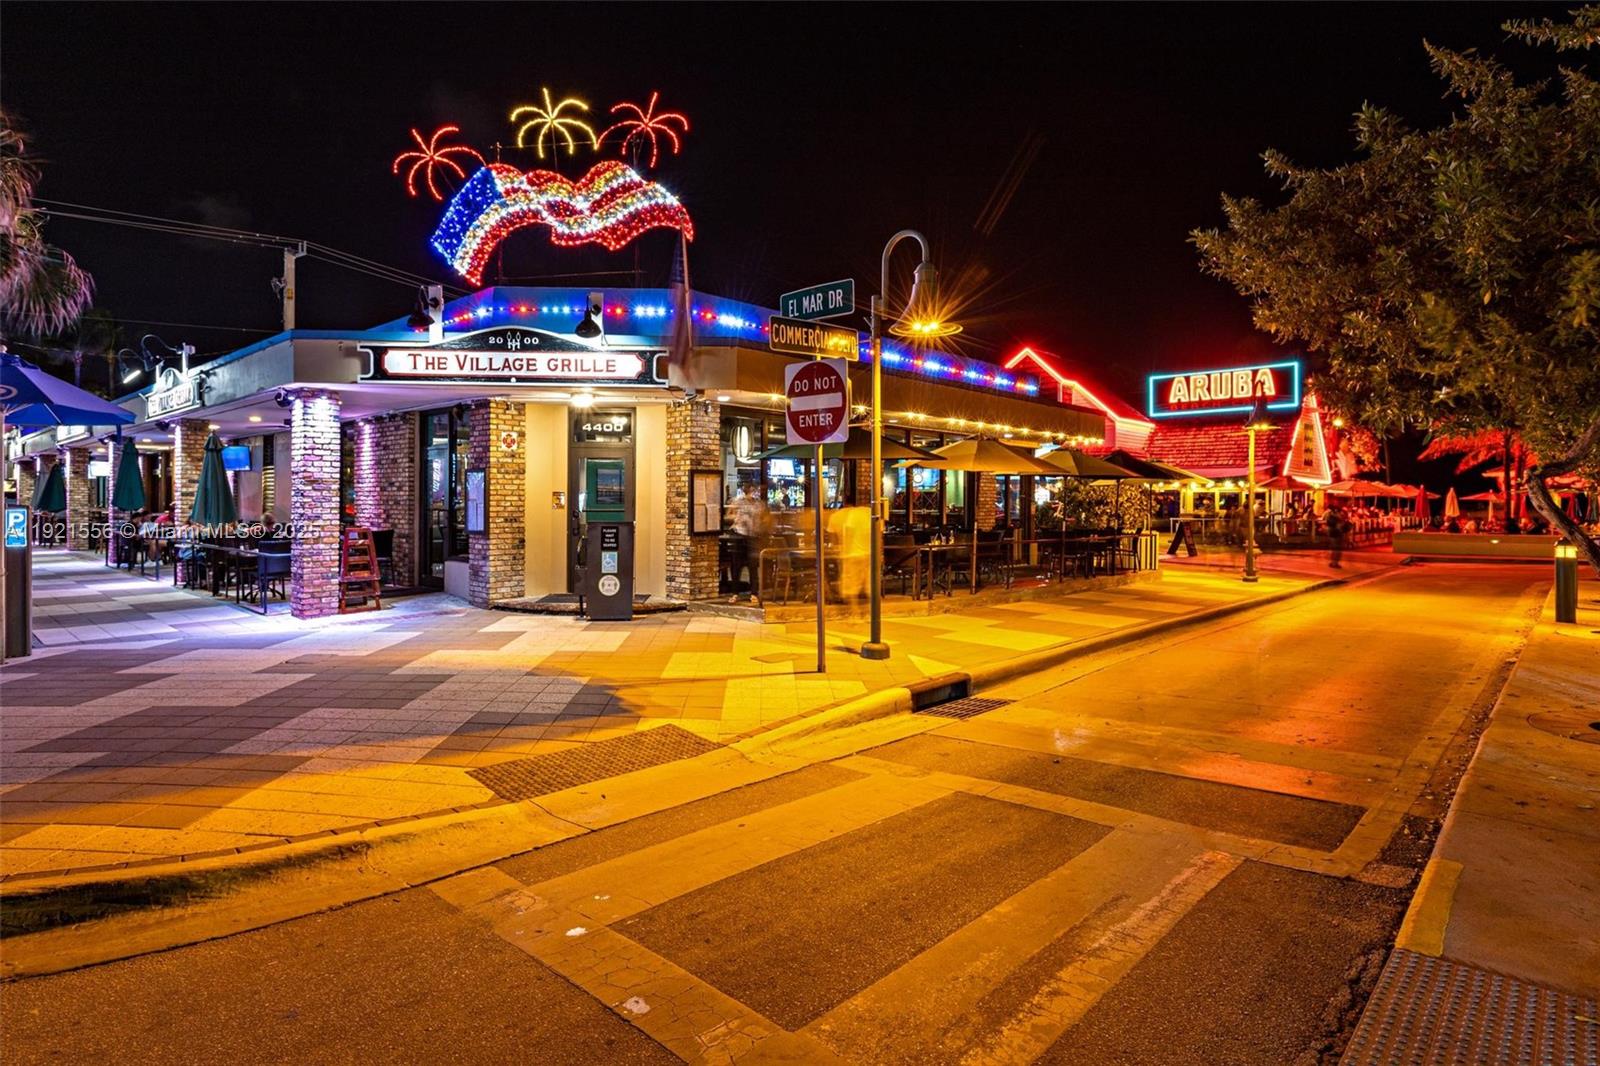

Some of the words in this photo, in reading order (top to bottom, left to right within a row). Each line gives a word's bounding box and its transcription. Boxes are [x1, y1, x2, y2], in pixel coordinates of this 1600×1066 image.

[788, 299, 799, 318] EL
[802, 292, 824, 314] MAR
[828, 288, 844, 308] DR
[772, 323, 834, 349] COMMERCIAL
[407, 353, 448, 371] THE
[455, 354, 538, 373] VILLAGE
[546, 358, 617, 373] GRILLE
[794, 379, 809, 393] DO
[814, 375, 837, 391] NOT
[1169, 368, 1275, 402] ARUBA
[582, 423, 624, 432] 4400
[799, 412, 833, 428] ENTER
[9, 512, 25, 528] P
